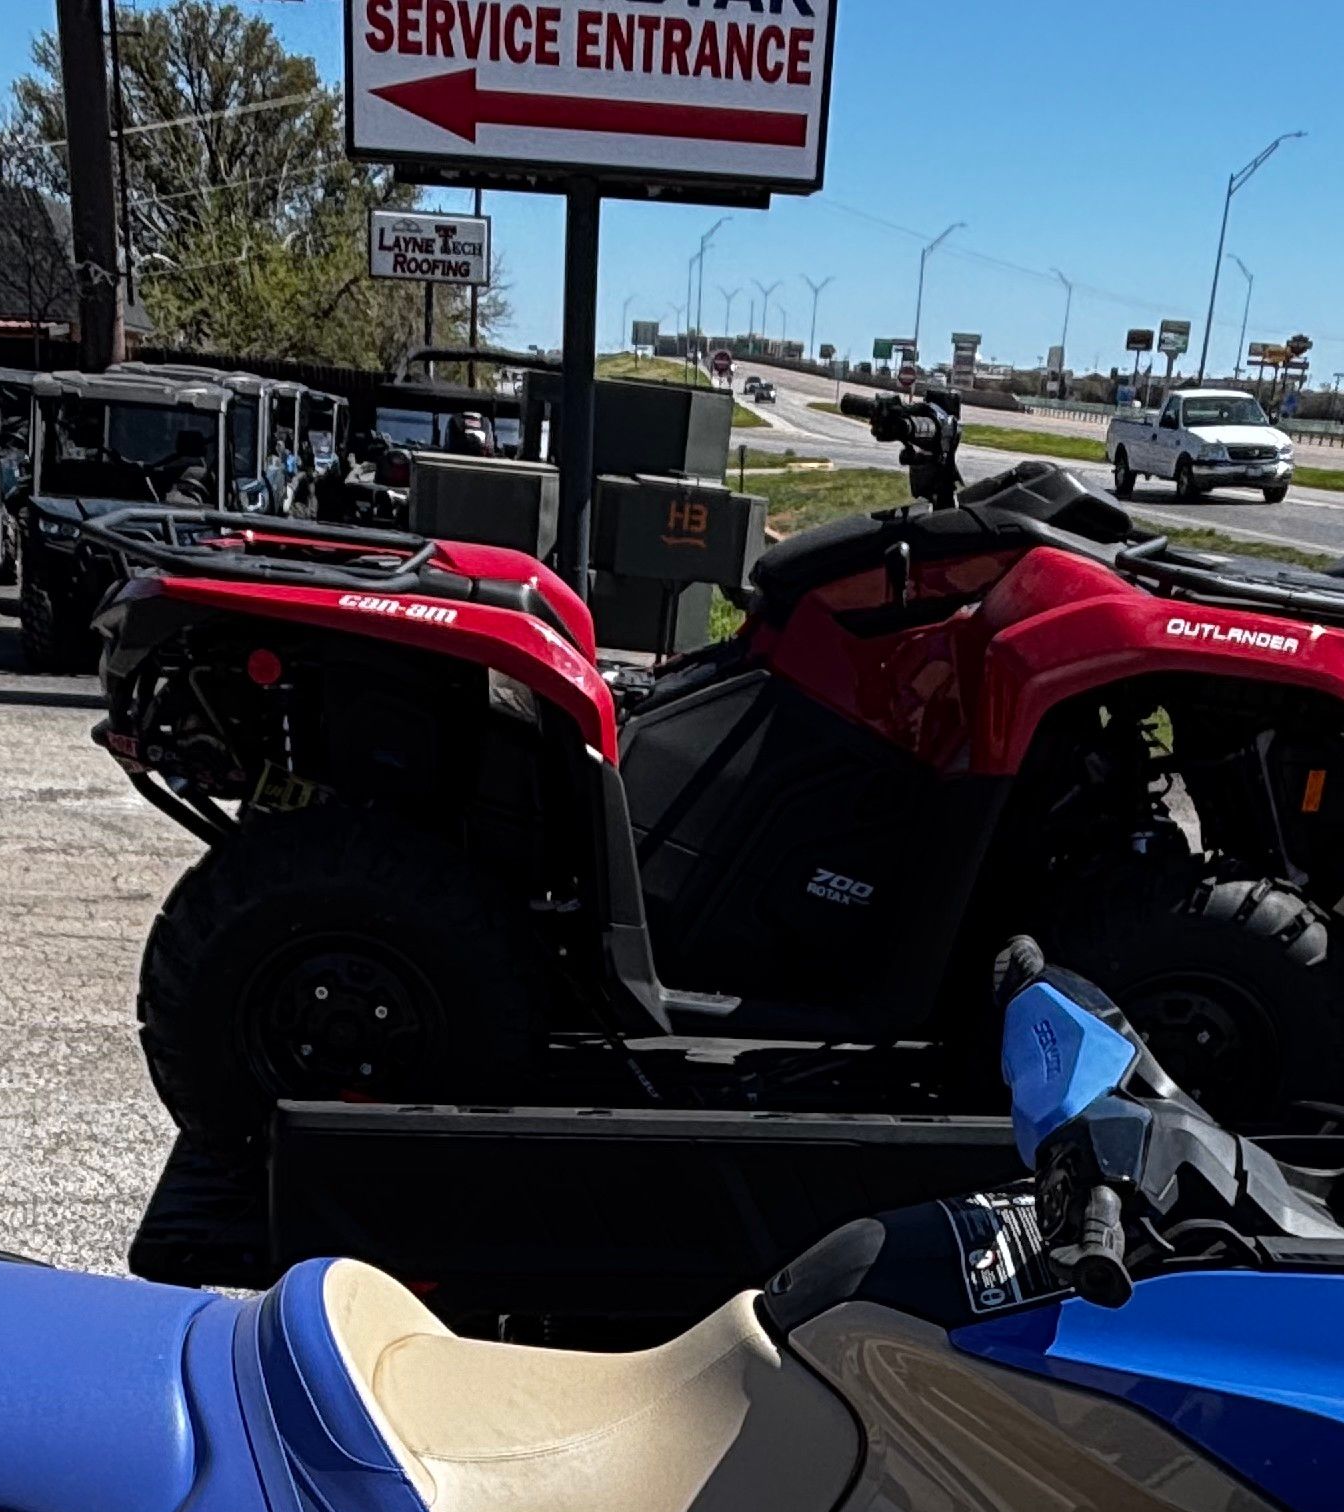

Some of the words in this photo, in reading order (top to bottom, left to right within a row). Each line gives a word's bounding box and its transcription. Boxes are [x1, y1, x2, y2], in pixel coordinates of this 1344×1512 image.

[365, 0, 561, 66] SERVICE
[576, 9, 815, 85] ENTRANCE
[378, 227, 435, 254] LAYNE
[393, 252, 471, 278] ROOFING
[338, 594, 458, 624] can-am
[1166, 618, 1299, 654] OUTLANDER
[812, 867, 874, 898] 700
